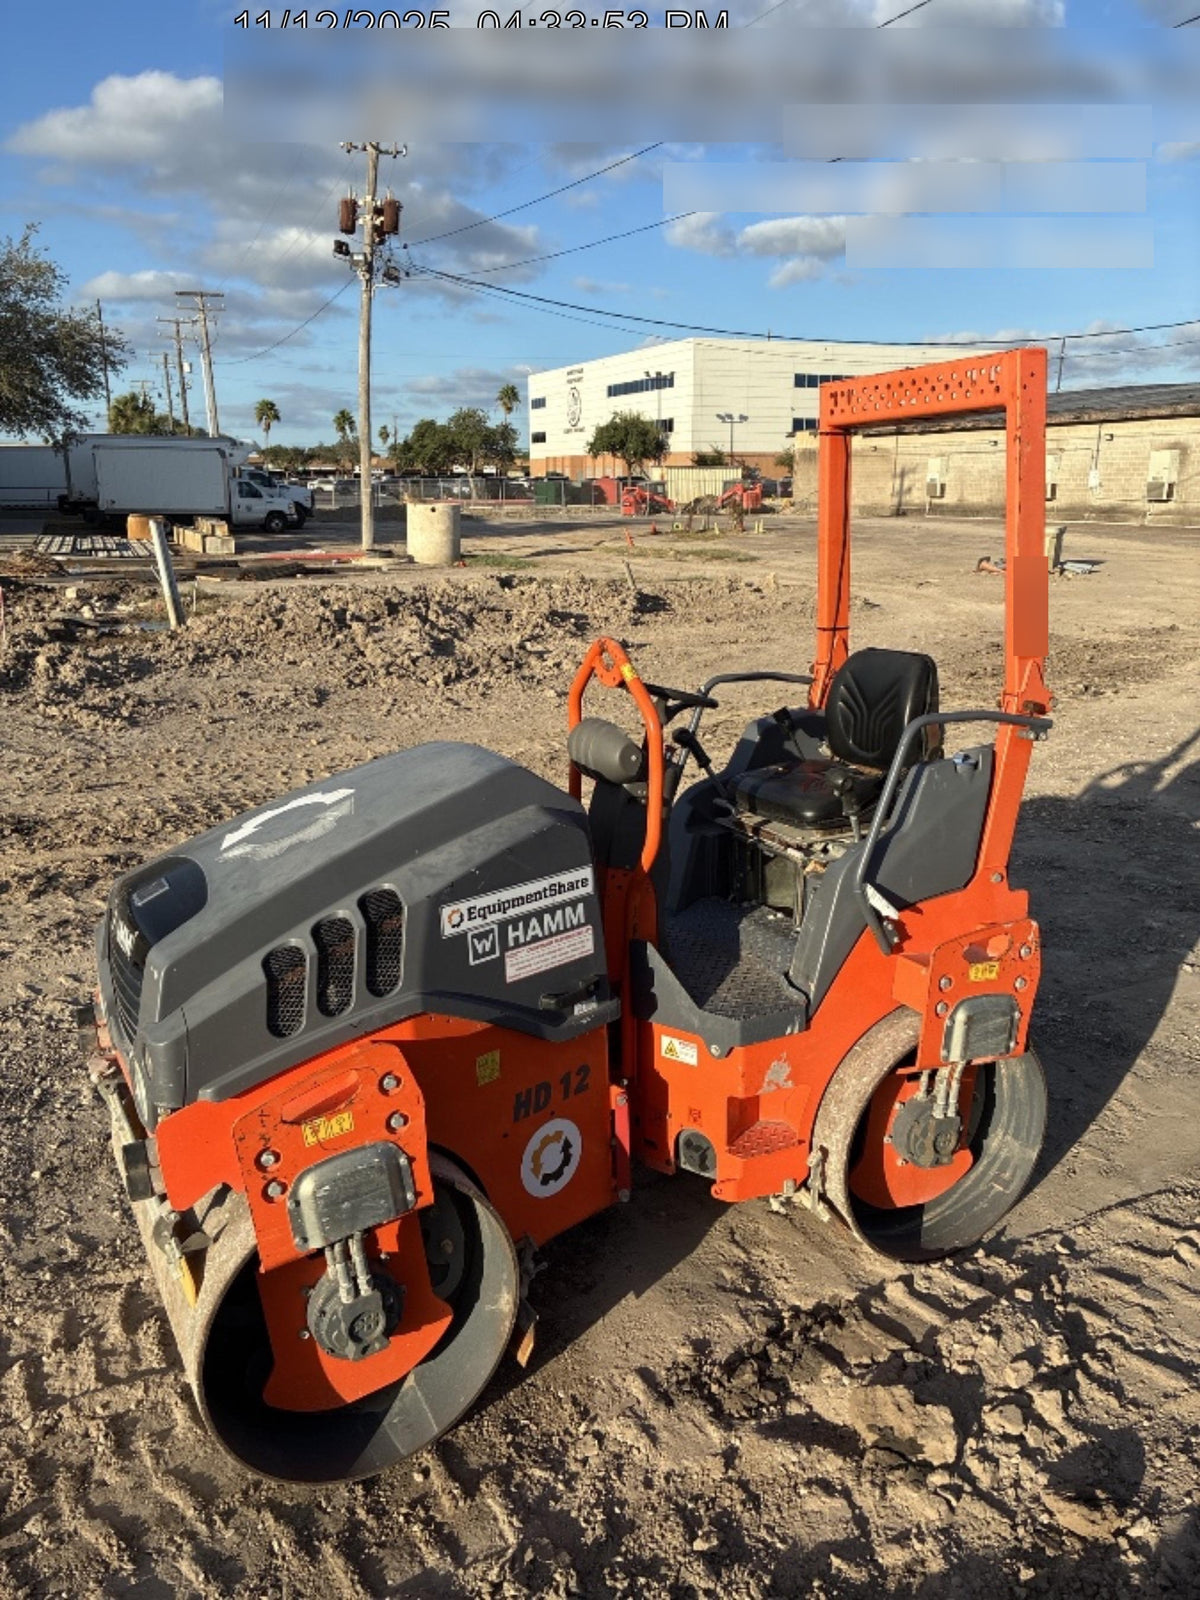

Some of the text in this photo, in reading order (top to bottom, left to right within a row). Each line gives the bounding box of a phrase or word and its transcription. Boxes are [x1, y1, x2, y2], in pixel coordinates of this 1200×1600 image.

[466, 881, 590, 922] EquipmentShare
[507, 902, 586, 947] HAMM
[513, 1065, 591, 1123] HD 12
